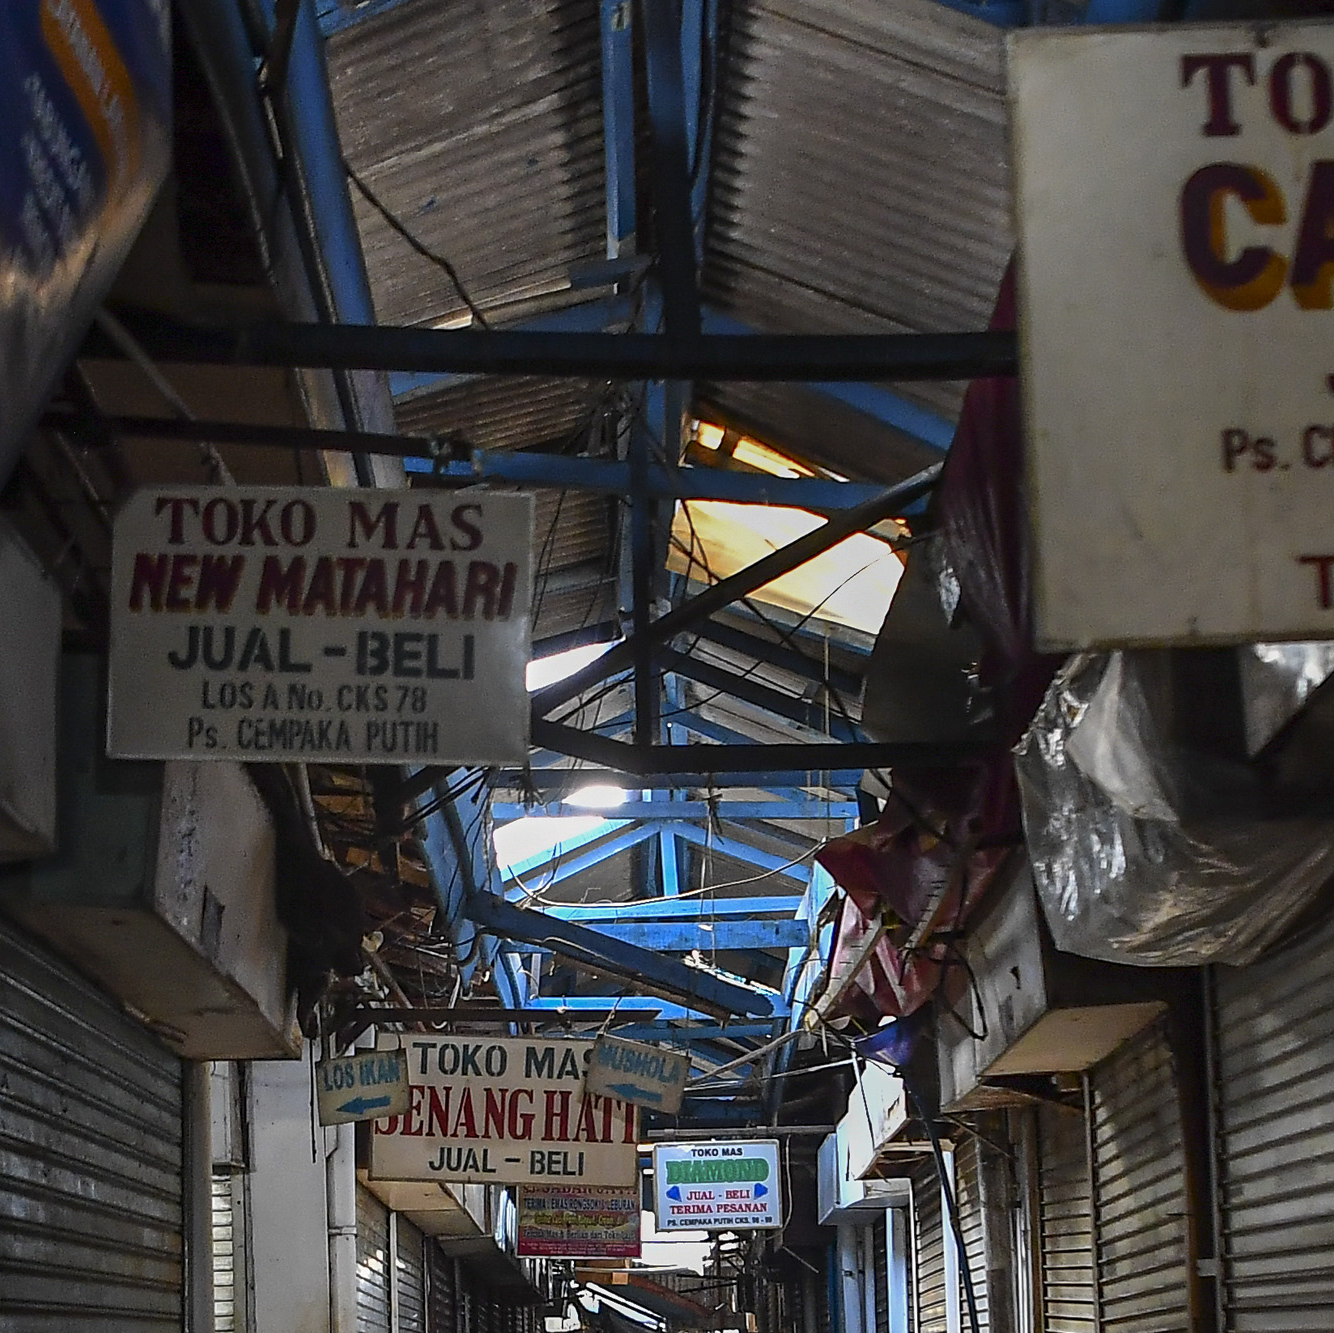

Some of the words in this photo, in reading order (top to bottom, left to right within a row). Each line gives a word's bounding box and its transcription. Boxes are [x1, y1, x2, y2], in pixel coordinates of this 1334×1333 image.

[1221, 427, 1290, 473] Ps.
[154, 496, 317, 548] TOKO
[347, 499, 485, 553] MAS
[128, 552, 246, 614] NEW
[255, 554, 519, 622] MATAHARI
[201, 680, 255, 710] LOS
[263, 683, 279, 712] A
[335, 684, 389, 712] CKS
[395, 685, 429, 714] 78
[187, 715, 228, 750] Ps.
[237, 716, 352, 751] CEMPAKA
[366, 720, 440, 753] PUTIH
[323, 1062, 355, 1092] LOS
[359, 1056, 402, 1087] IKAN
[412, 1042, 508, 1077] TOKO
[428, 1146, 497, 1174] JUAL
[529, 1150, 585, 1176] BELI
[691, 1148, 719, 1158] TOKO
[722, 1147, 743, 1156] MAS
[666, 1158, 769, 1184] DIAMOND
[669, 1204, 713, 1215] TERIMA
[716, 1203, 768, 1213] PESANAN
[686, 1190, 715, 1201] JUAL
[725, 1189, 751, 1200] BELI
